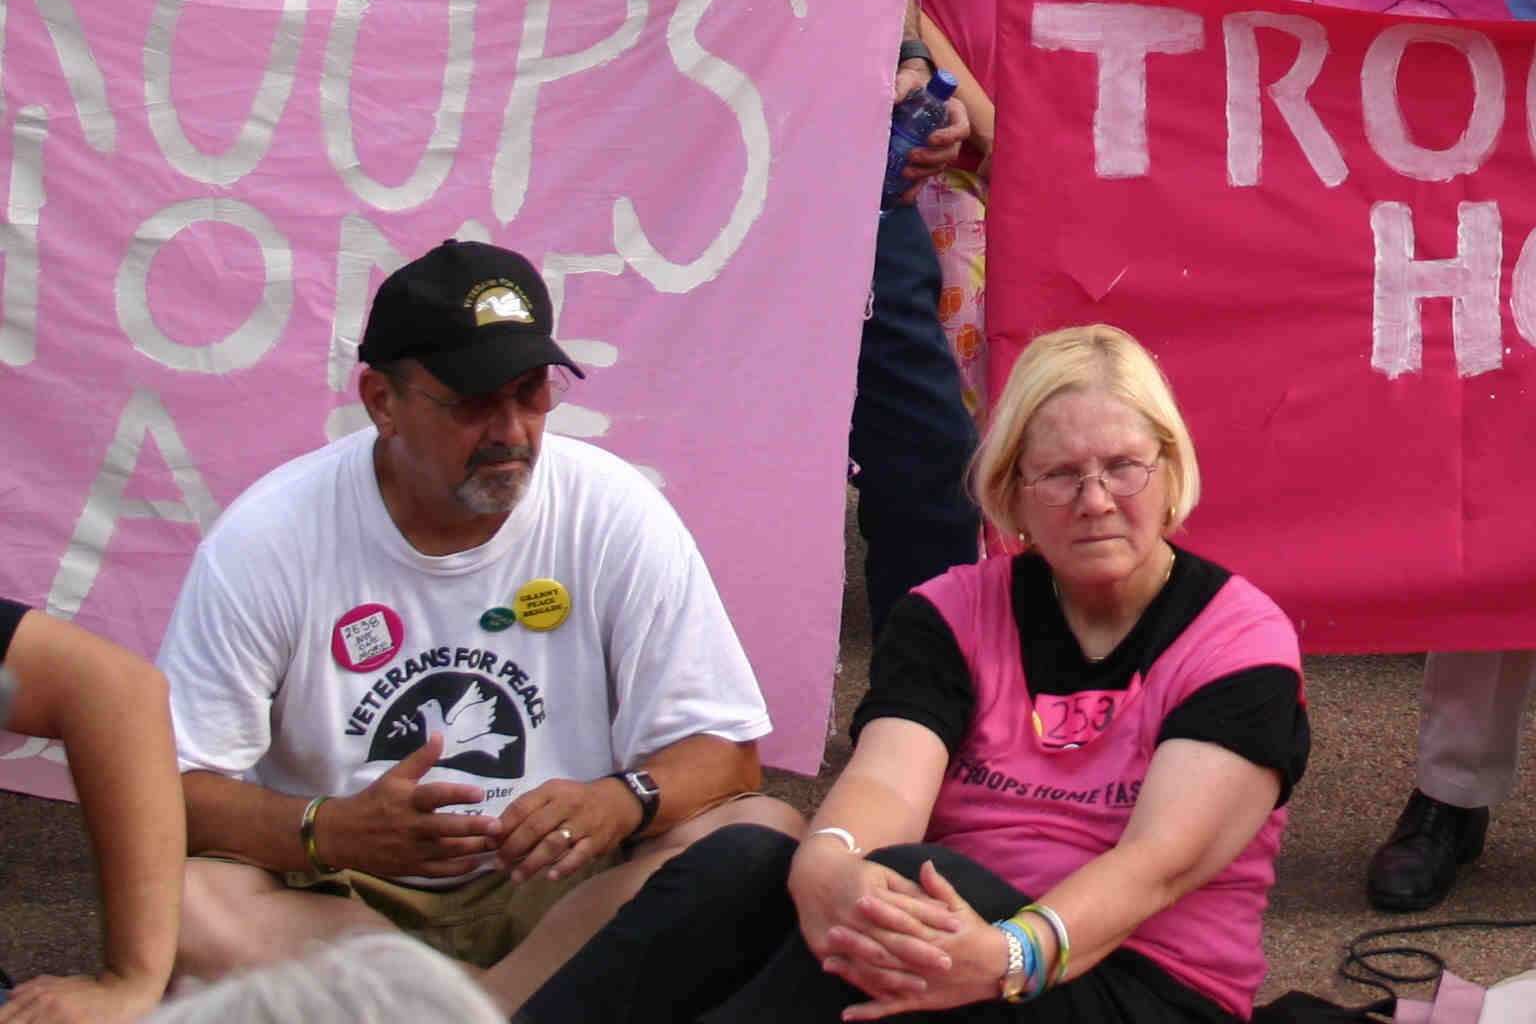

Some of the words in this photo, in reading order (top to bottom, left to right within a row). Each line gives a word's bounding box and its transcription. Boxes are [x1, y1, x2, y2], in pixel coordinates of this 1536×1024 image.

[345, 647, 450, 736] VETERANS
[454, 647, 498, 673] FOR
[498, 660, 547, 729] PEACE
[952, 760, 1033, 796] TROOPS
[1033, 785, 1102, 804] HOME
[1104, 779, 1144, 806] FAS
